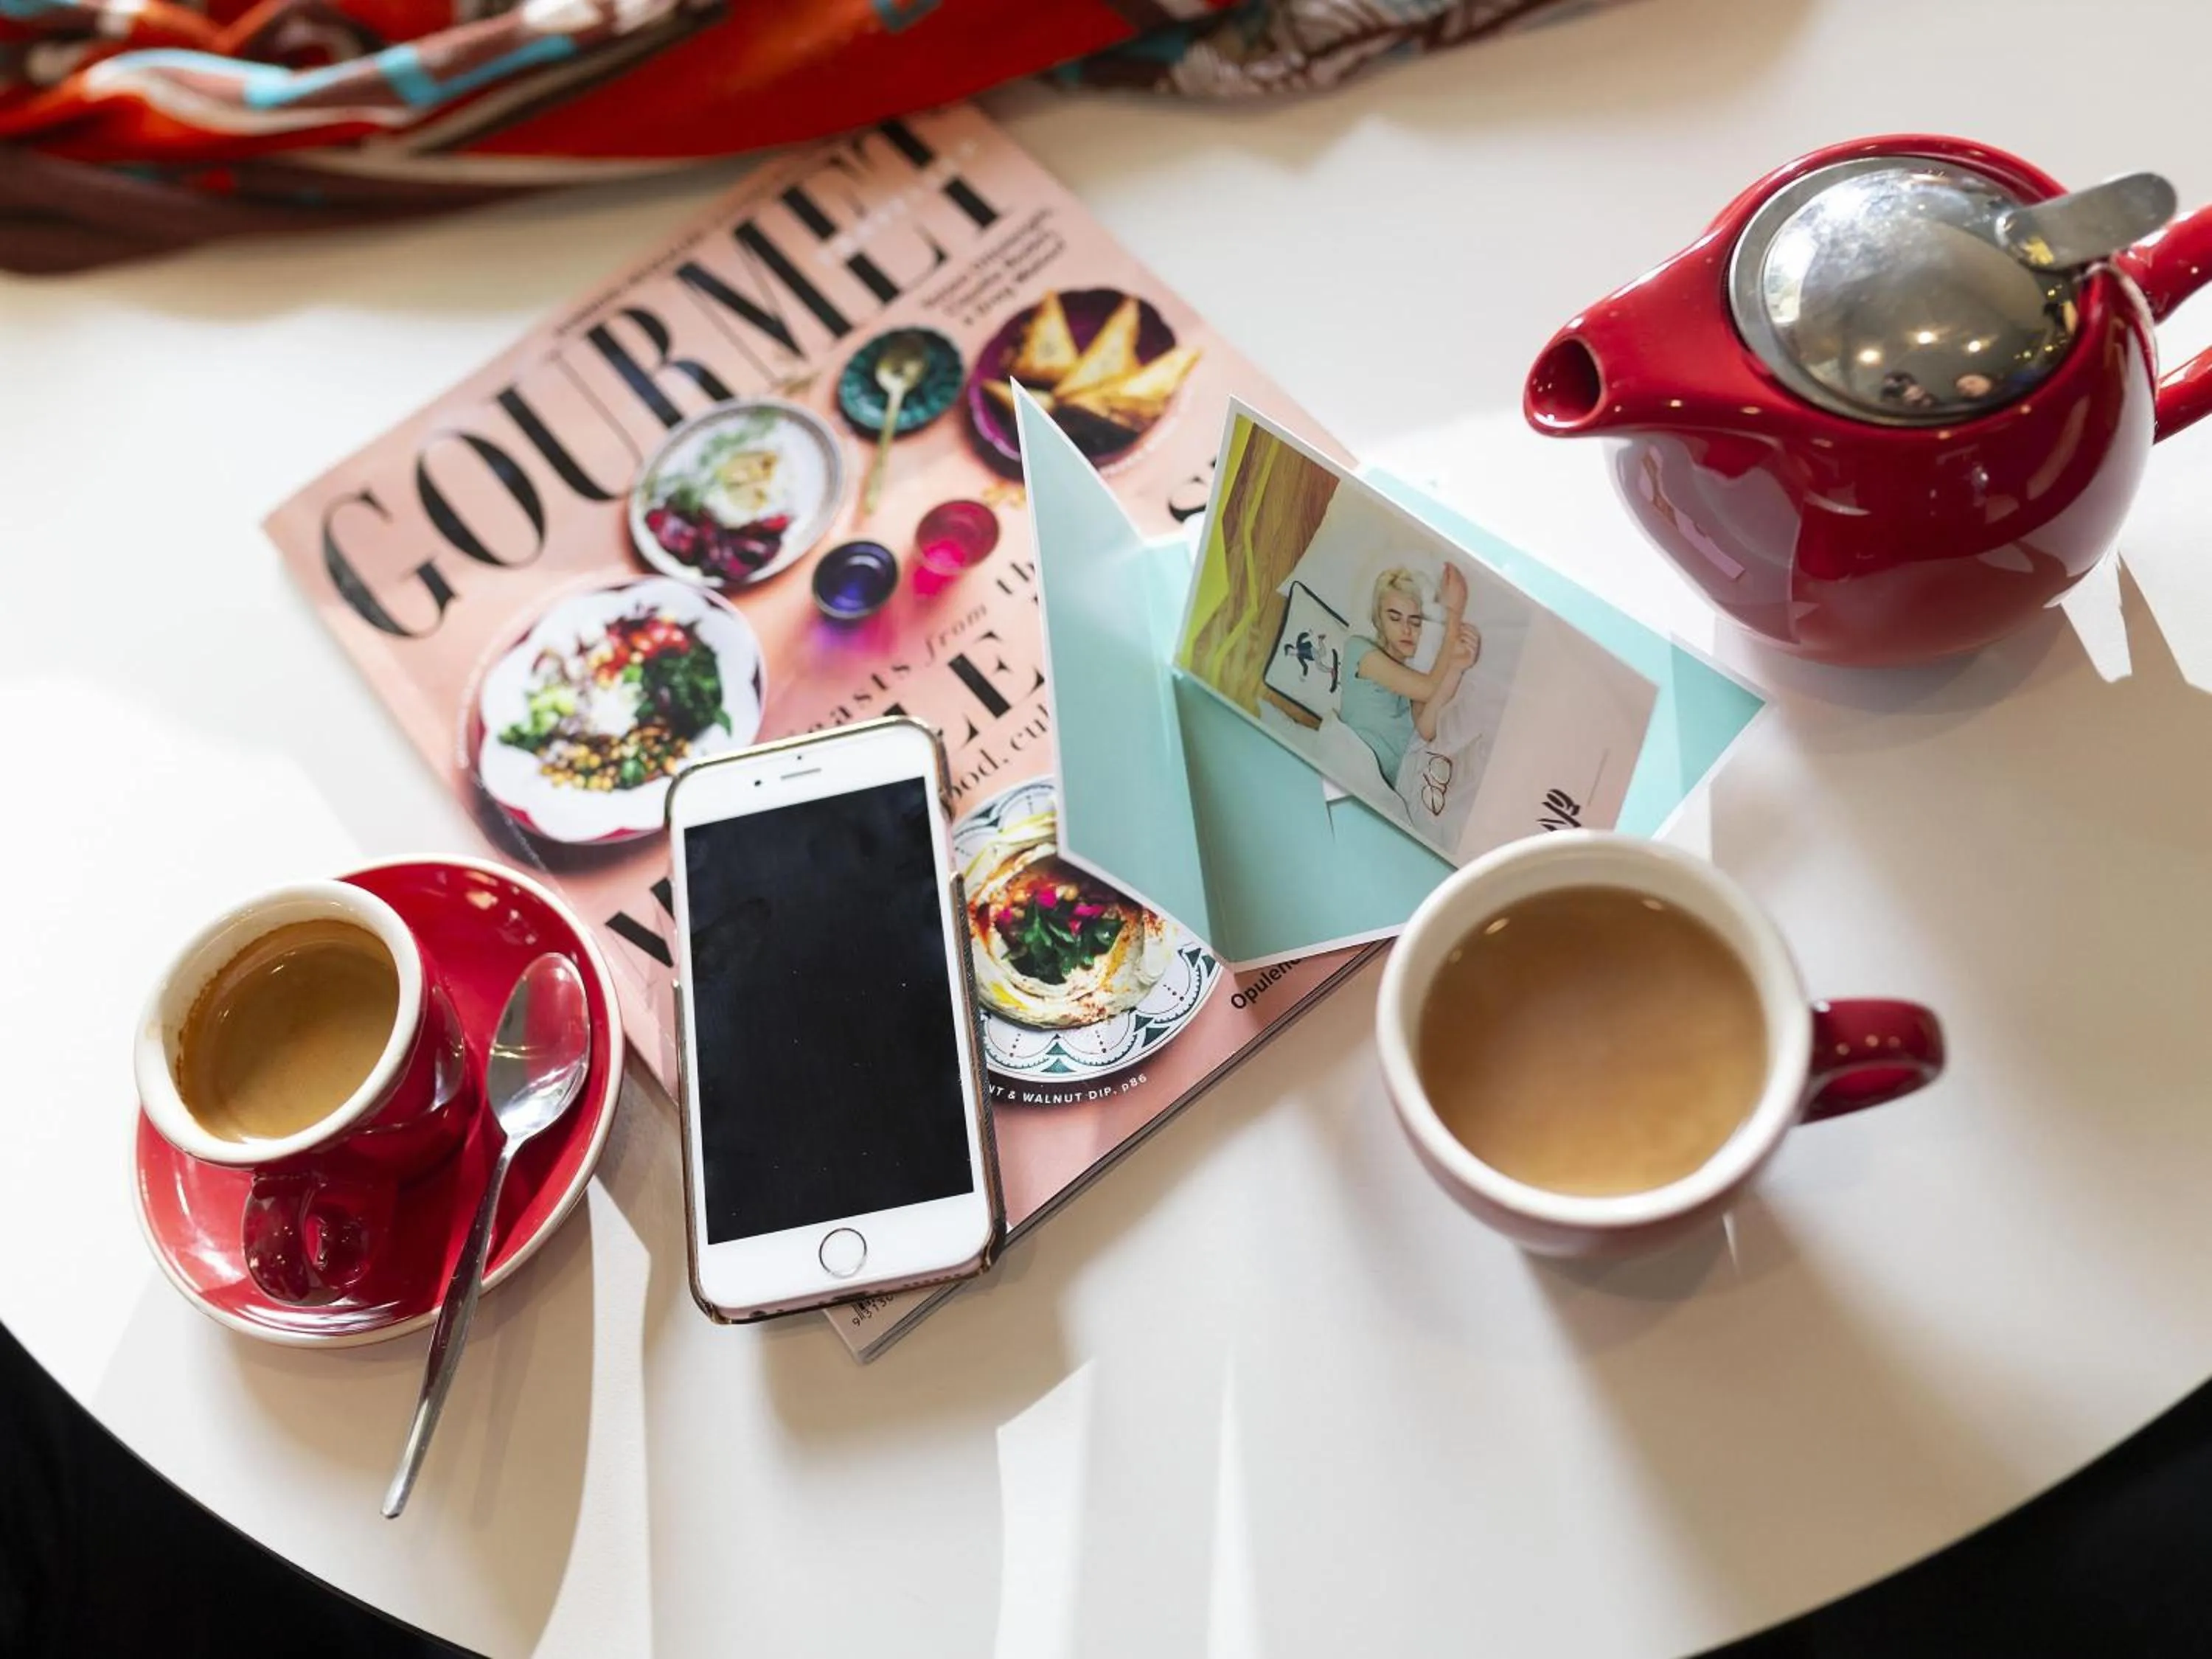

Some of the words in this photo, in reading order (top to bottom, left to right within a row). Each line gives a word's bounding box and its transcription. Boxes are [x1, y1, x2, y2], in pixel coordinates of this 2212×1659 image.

[321, 113, 1012, 640] GOURMET
[925, 603, 987, 667] from
[996, 561, 1035, 595] th
[1231, 959, 1301, 1009] Opulen
[988, 1084, 1005, 1096] NT
[1007, 1090, 1016, 1100] &
[1022, 1091, 1082, 1105] WALNUT
[1121, 1073, 1147, 1092] p86
